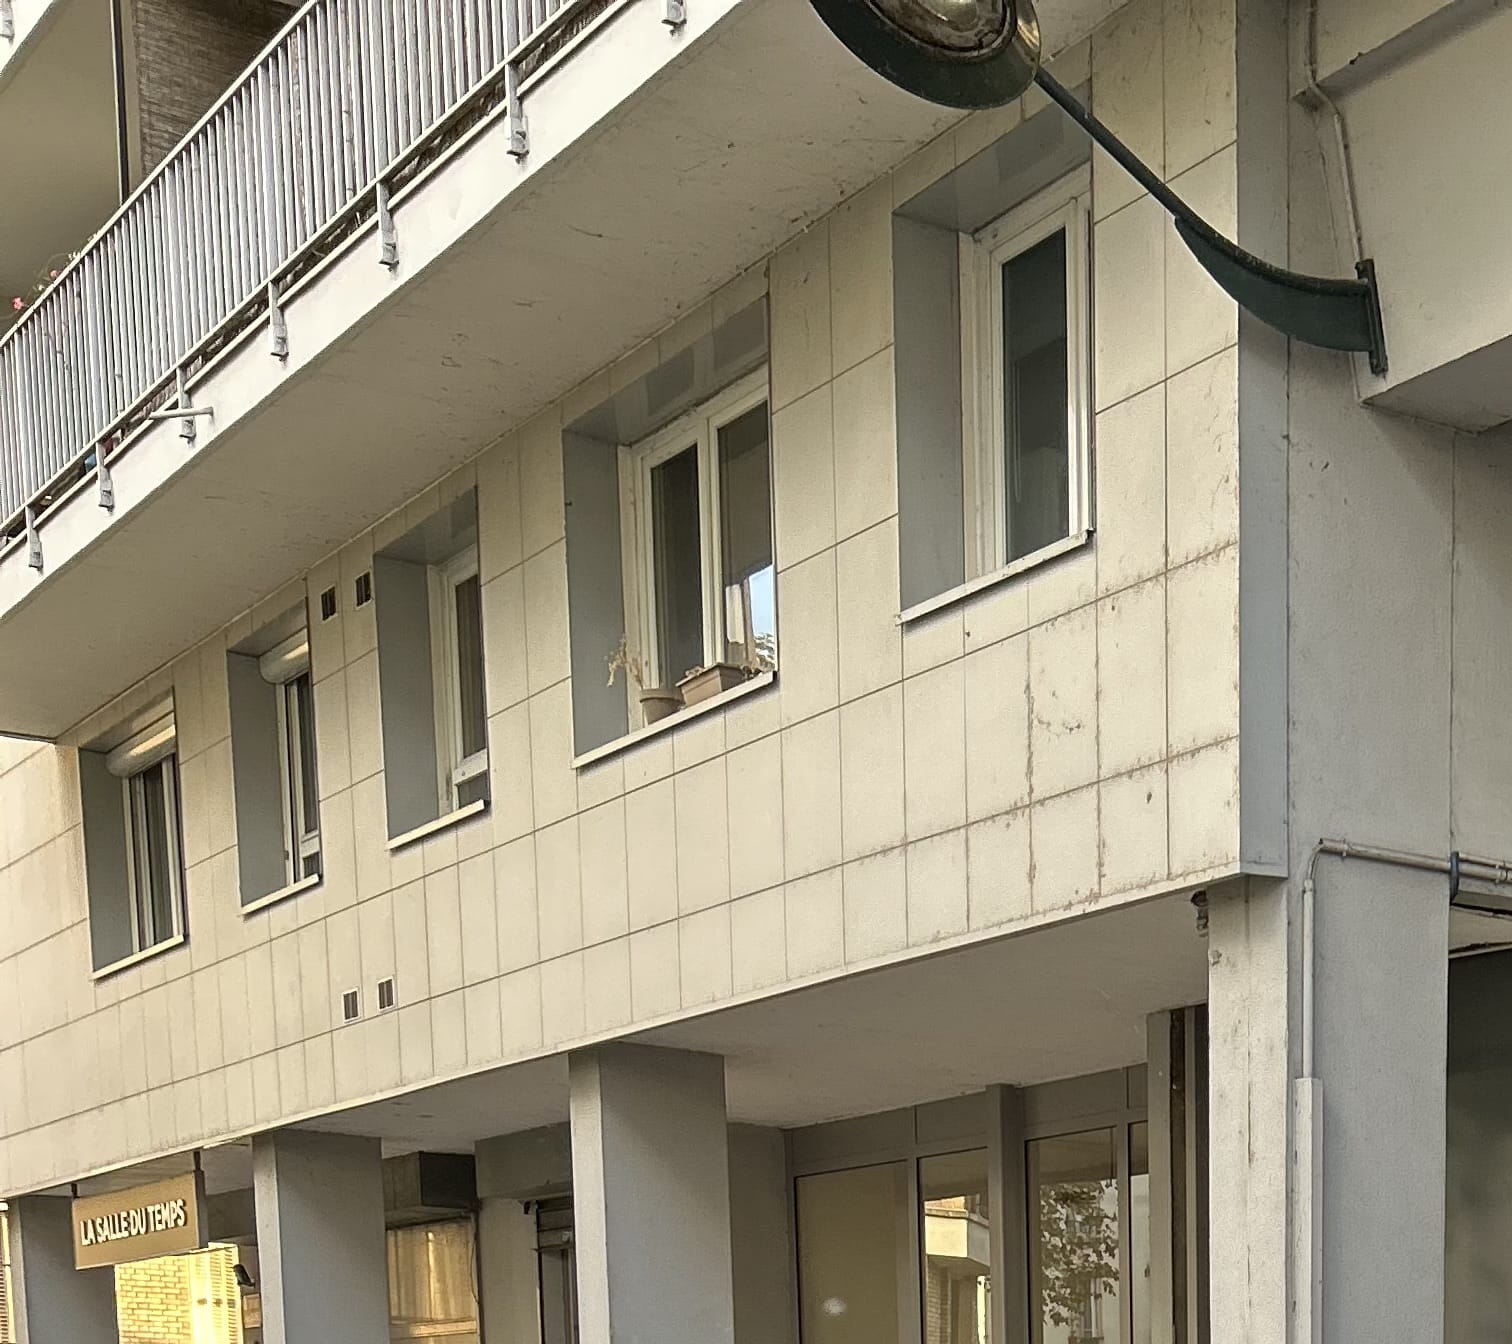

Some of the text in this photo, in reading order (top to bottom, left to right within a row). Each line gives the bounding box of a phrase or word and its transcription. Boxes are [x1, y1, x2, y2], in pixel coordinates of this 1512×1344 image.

[80, 1198, 186, 1246] LA SALLE DU TEMPS
